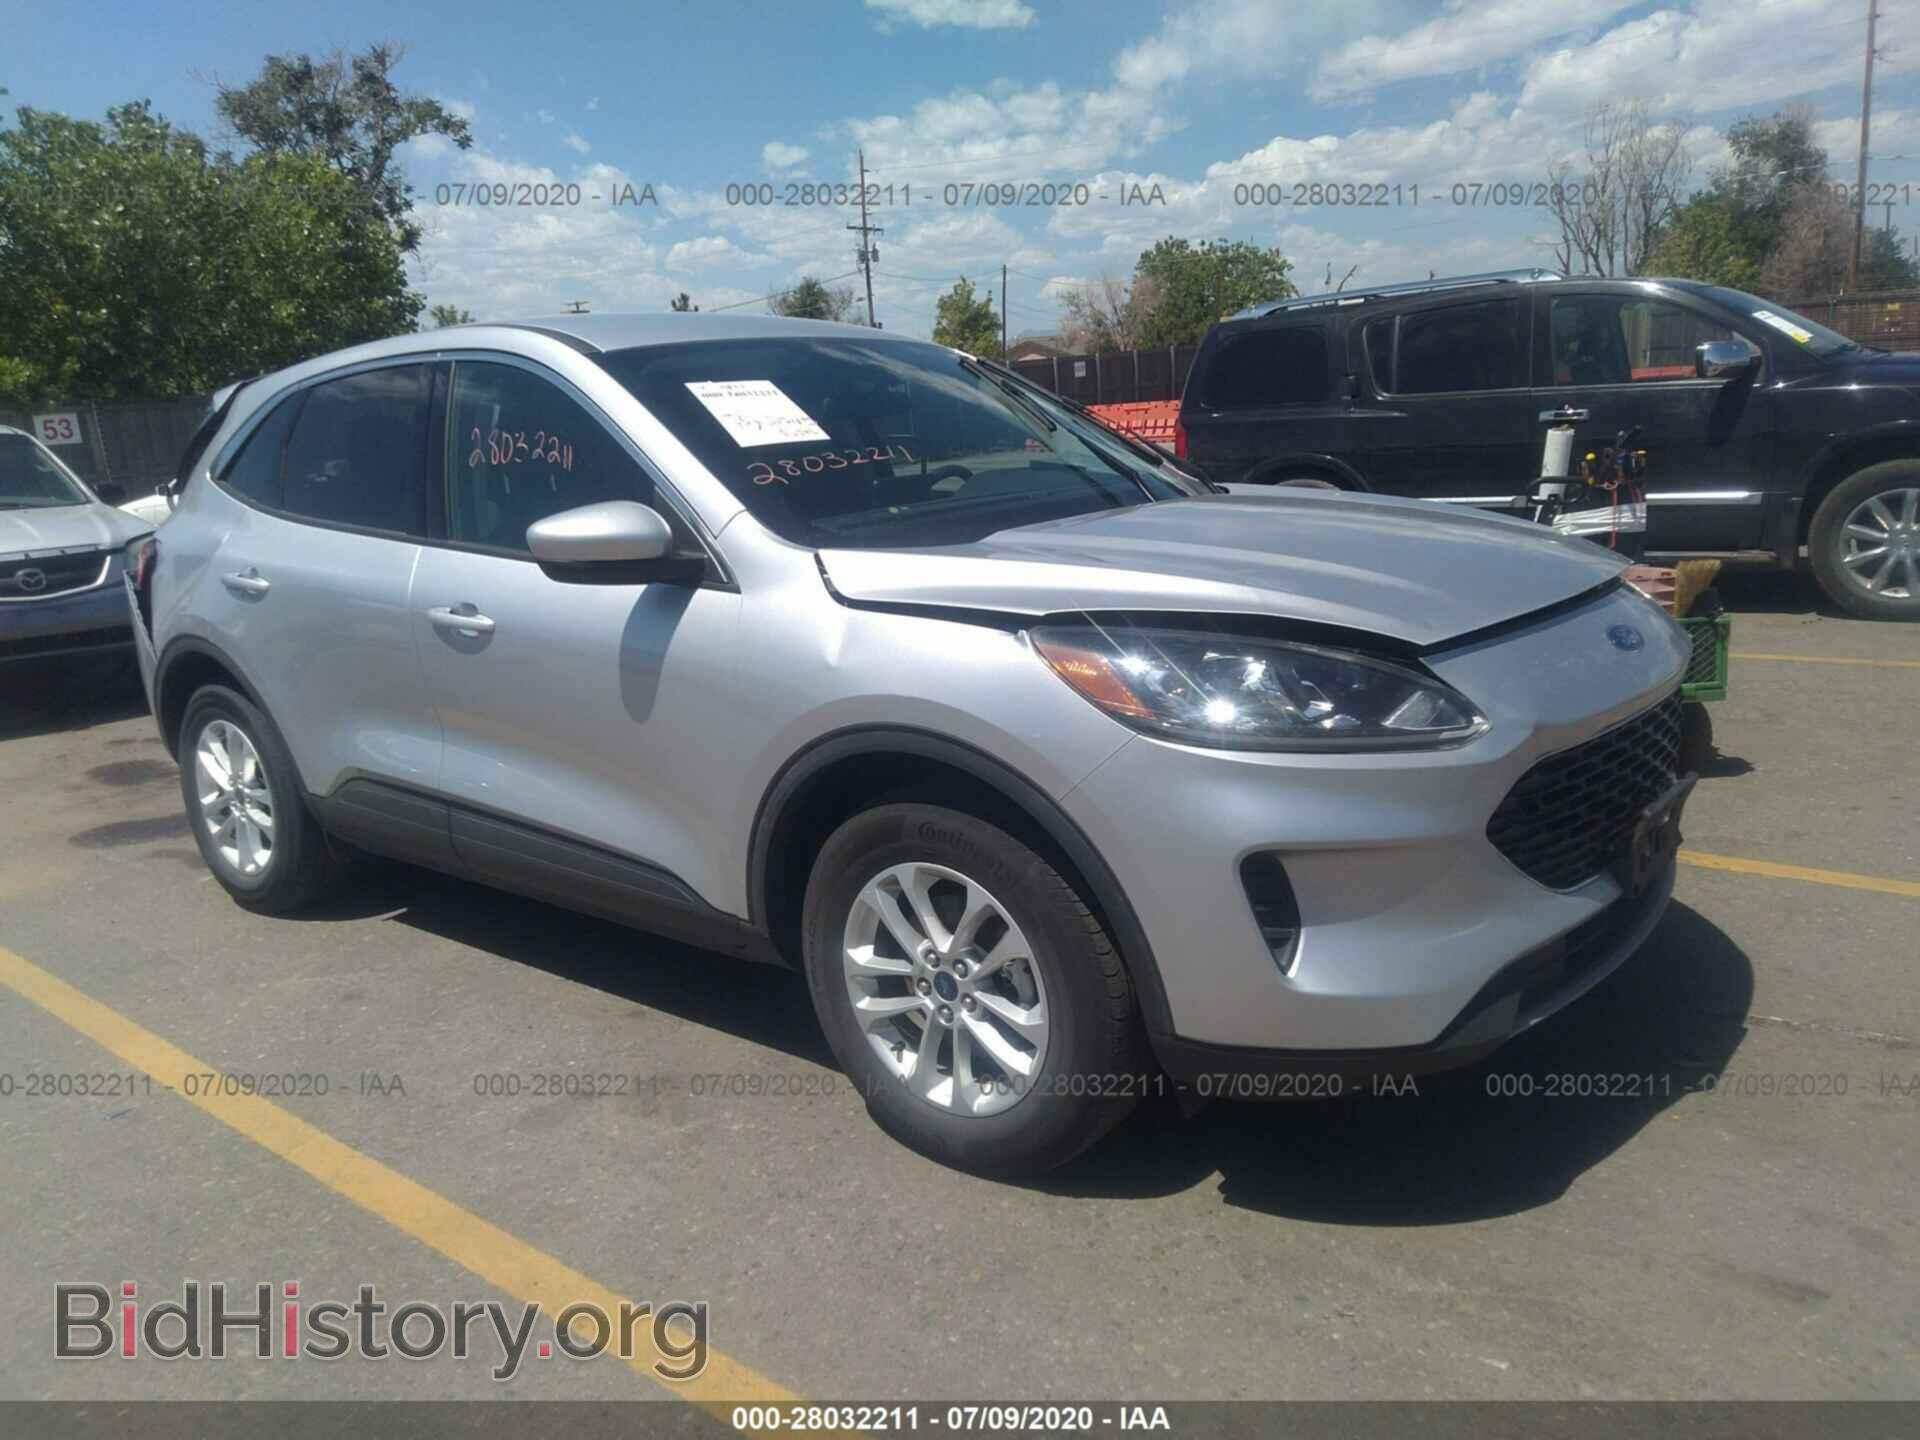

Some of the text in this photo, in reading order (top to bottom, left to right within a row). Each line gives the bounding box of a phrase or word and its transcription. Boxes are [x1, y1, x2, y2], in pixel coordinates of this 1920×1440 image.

[43, 418, 74, 440] 53
[468, 425, 574, 472] 28032211
[746, 444, 914, 485] 28032211
